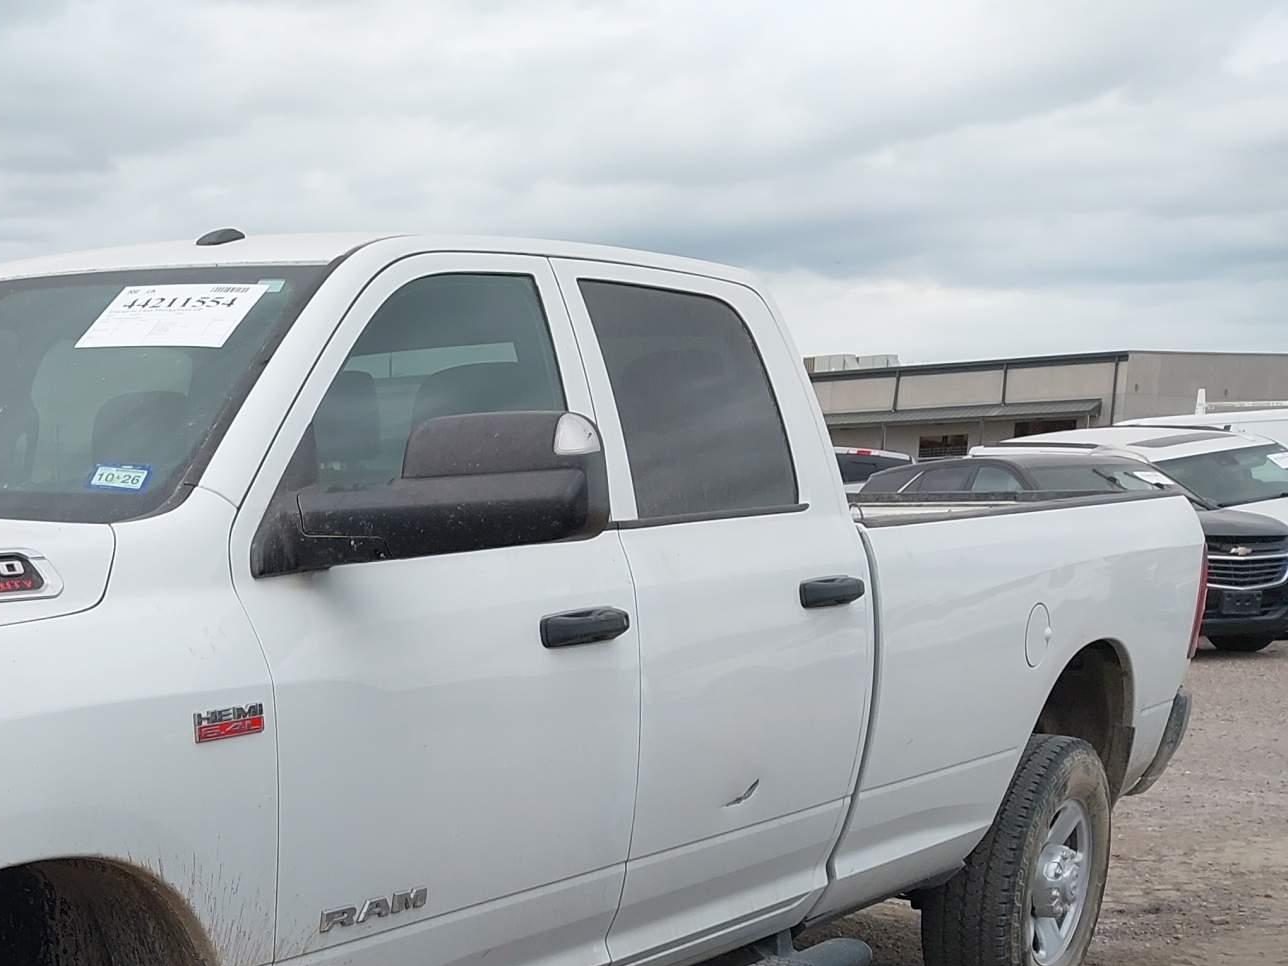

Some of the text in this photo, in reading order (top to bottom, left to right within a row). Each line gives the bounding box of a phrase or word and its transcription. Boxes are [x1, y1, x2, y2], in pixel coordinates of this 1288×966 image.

[123, 296, 239, 309] 44211554
[193, 702, 264, 727] HEMI
[319, 887, 428, 933] RAM
